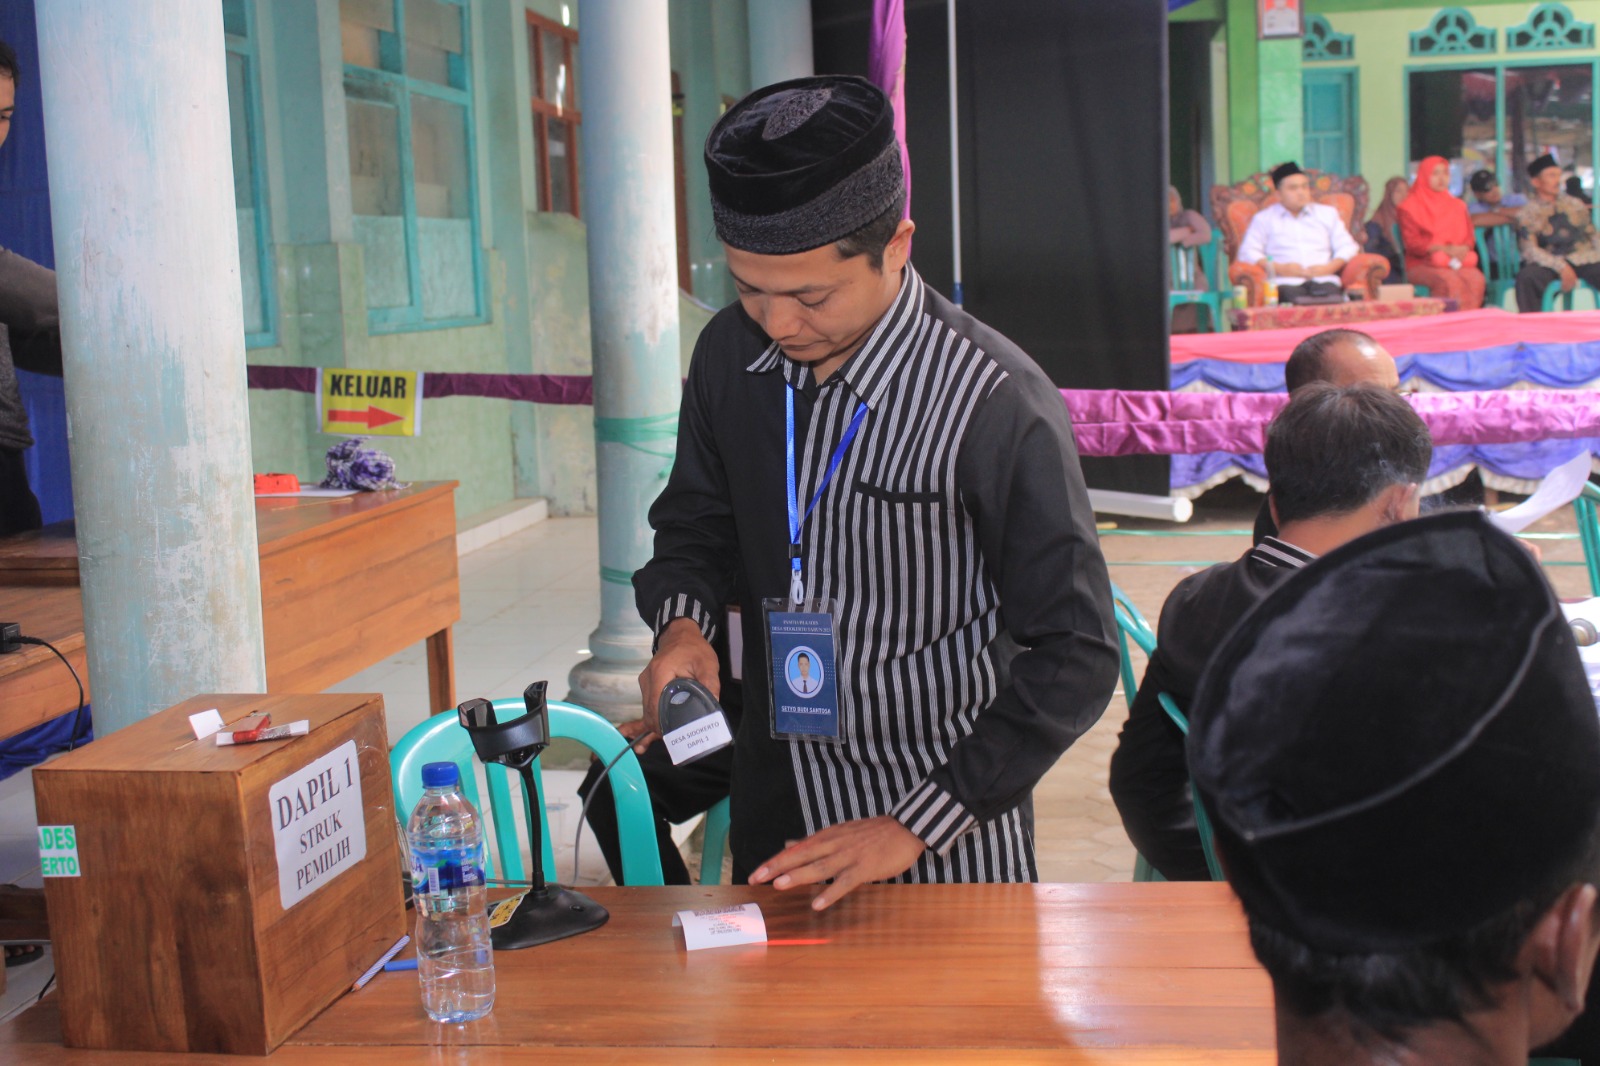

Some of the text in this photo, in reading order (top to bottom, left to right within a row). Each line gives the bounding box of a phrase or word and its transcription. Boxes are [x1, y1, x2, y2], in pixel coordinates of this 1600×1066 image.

[330, 374, 406, 399] KELUAR
[671, 721, 720, 746] DESA SIDOKERTO
[687, 738, 706, 749] DAPIL
[277, 757, 353, 831] DAPIL 1
[300, 810, 343, 854] STRUK
[296, 836, 351, 891] PEMILIH
